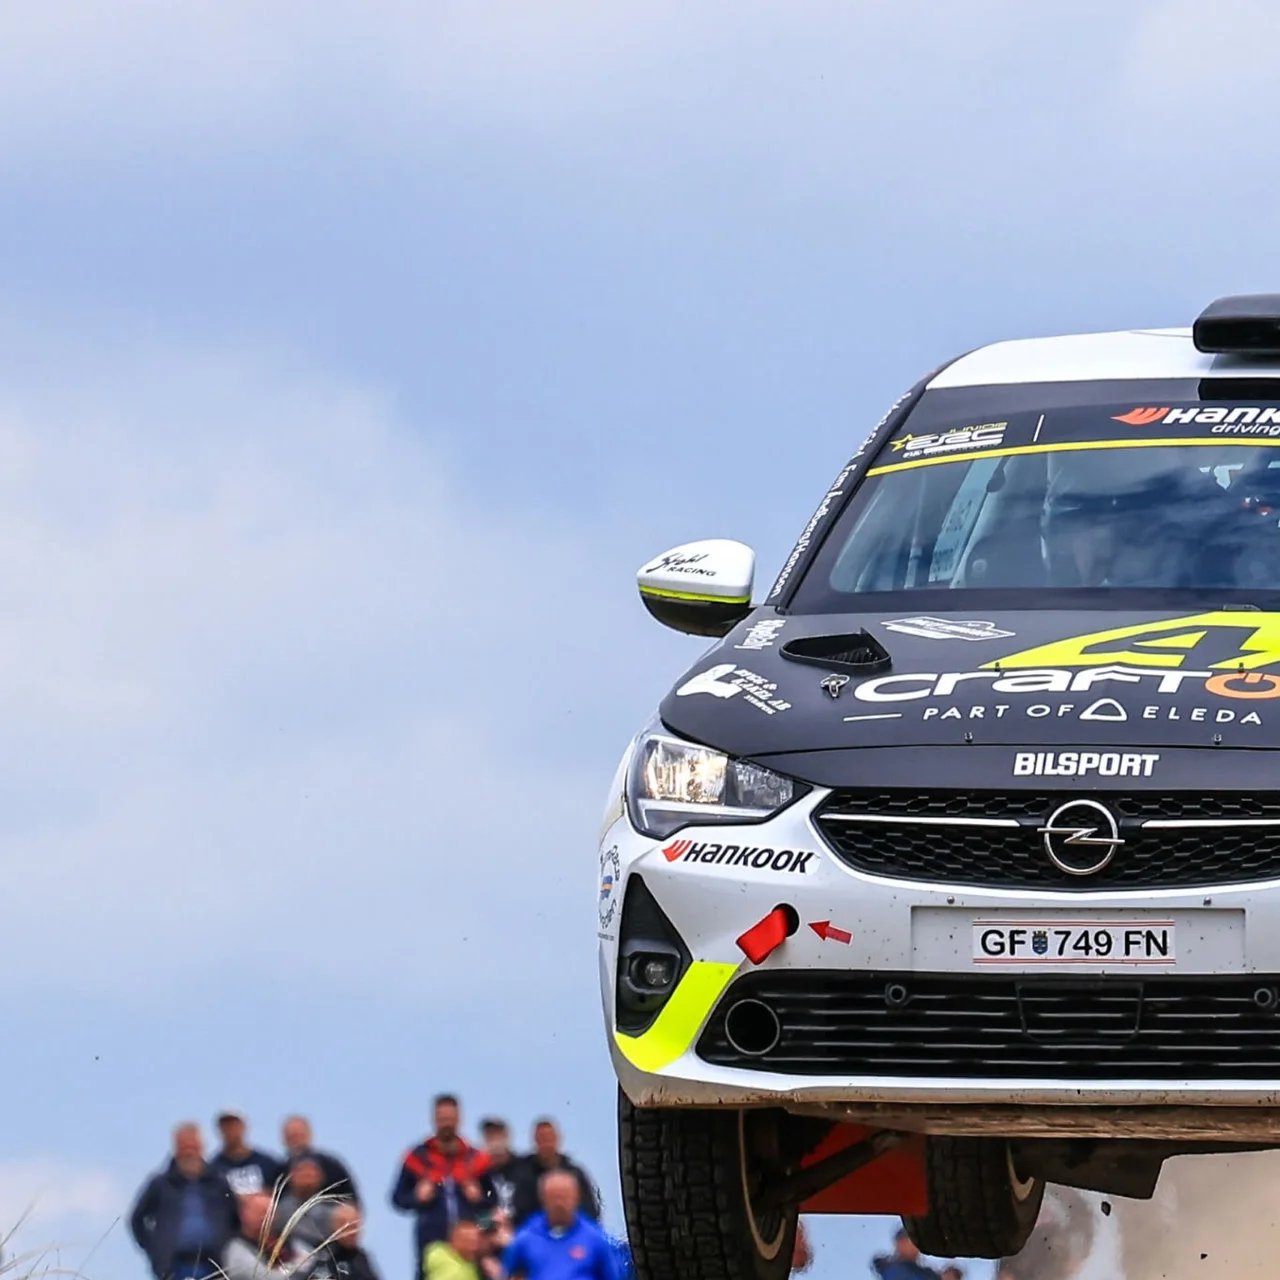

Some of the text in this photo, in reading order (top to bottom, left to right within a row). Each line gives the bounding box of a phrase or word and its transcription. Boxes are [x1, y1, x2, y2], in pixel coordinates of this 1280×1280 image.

[666, 566, 717, 577] RACING
[923, 704, 1263, 725] PART OF ELEDA
[1013, 752, 1159, 776] BILSPORT
[981, 929, 1168, 956] GF 749 FN
